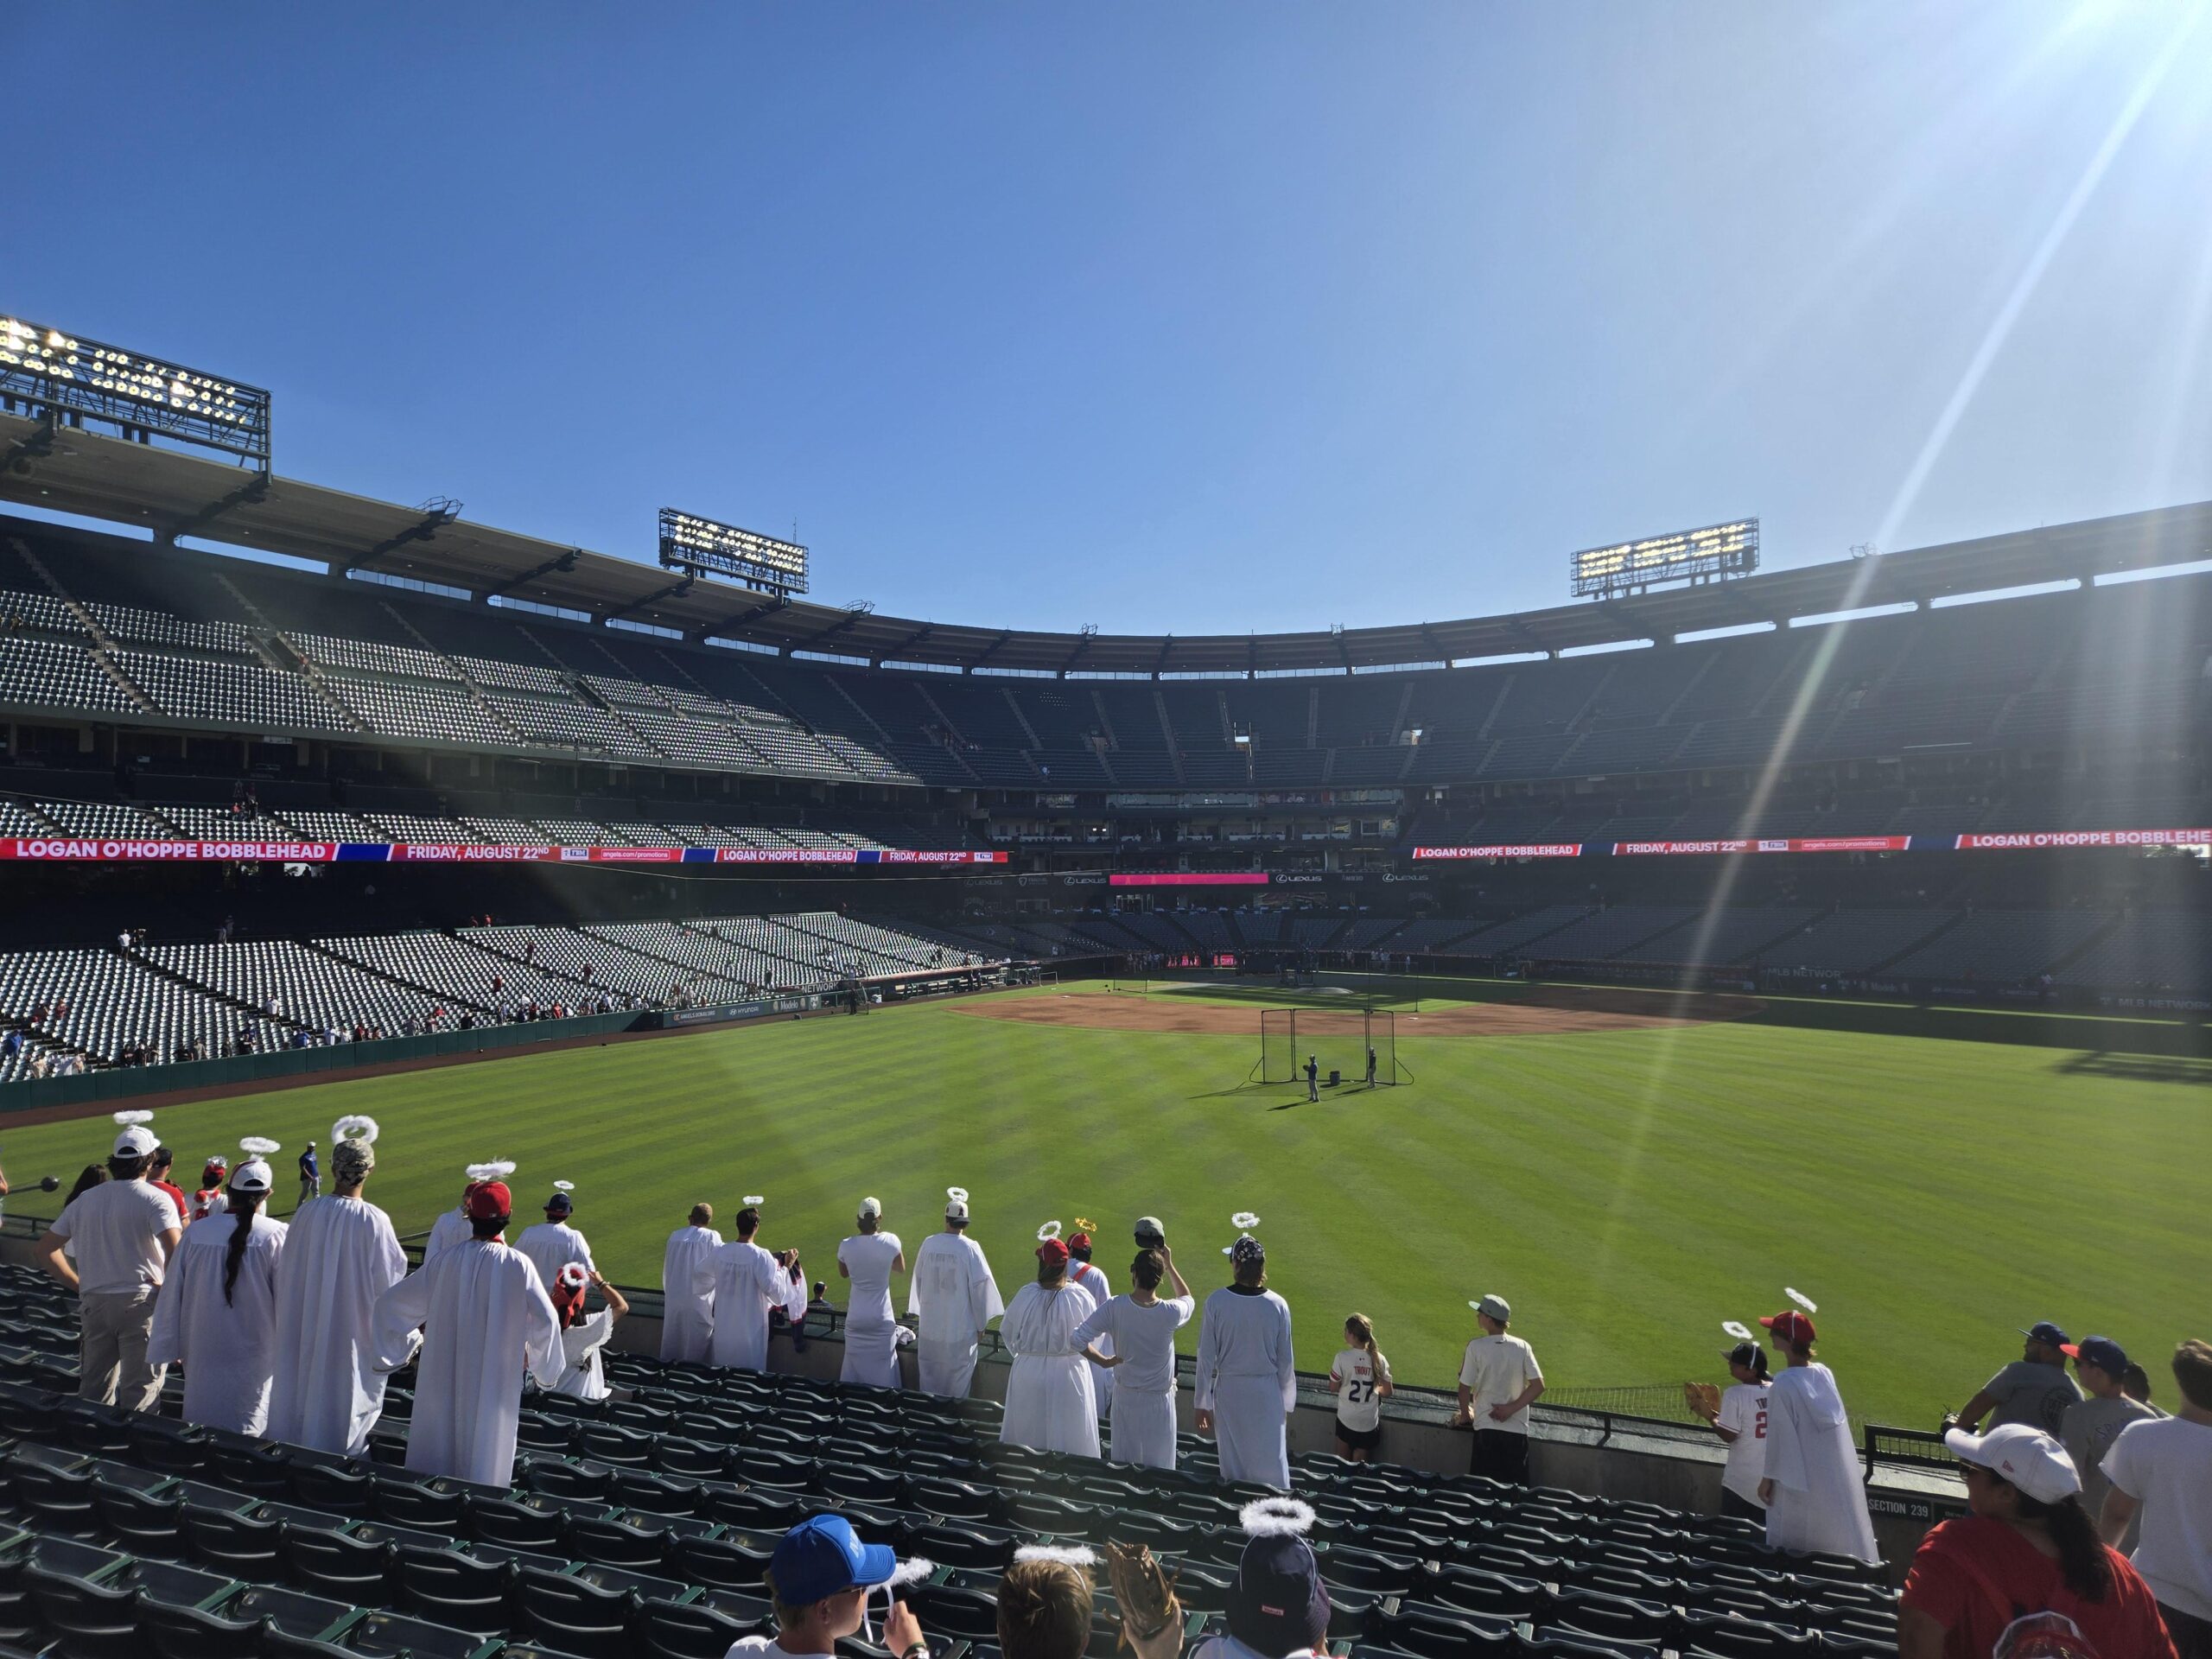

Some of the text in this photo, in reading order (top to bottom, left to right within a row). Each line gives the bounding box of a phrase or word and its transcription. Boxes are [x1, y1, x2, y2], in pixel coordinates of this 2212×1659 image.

[1973, 835, 2030, 847] LOGAN
[2034, 833, 2111, 846] O'HOPPE
[16, 841, 326, 859] LOGAN O'HOPPE BOBBLEHEAD
[1421, 846, 1573, 857] LOGAN O'HOPPE BOBBLEHEAD
[1626, 841, 1747, 854] FRIDAY, AUGUST 22ND
[407, 846, 550, 861] FRIDAY, AUGUST 22ND
[723, 850, 854, 861] LOGAN O'HOPPE BOBBLEHEAD
[889, 852, 967, 862] FRIDAY, AUGUST 22ND
[1793, 969, 1845, 978] NETWOR
[802, 982, 839, 994] NETWORK
[780, 1000, 798, 1010] Modelo
[2119, 998, 2145, 1007] MLB
[737, 1006, 759, 1014] HYUNDAI
[1354, 1366, 1371, 1376] TROUT
[1349, 1380, 1375, 1402] 27
[1755, 1411, 1768, 1439] 2
[1868, 1498, 1906, 1515] SECTION
[1910, 1504, 1929, 1517] 239
